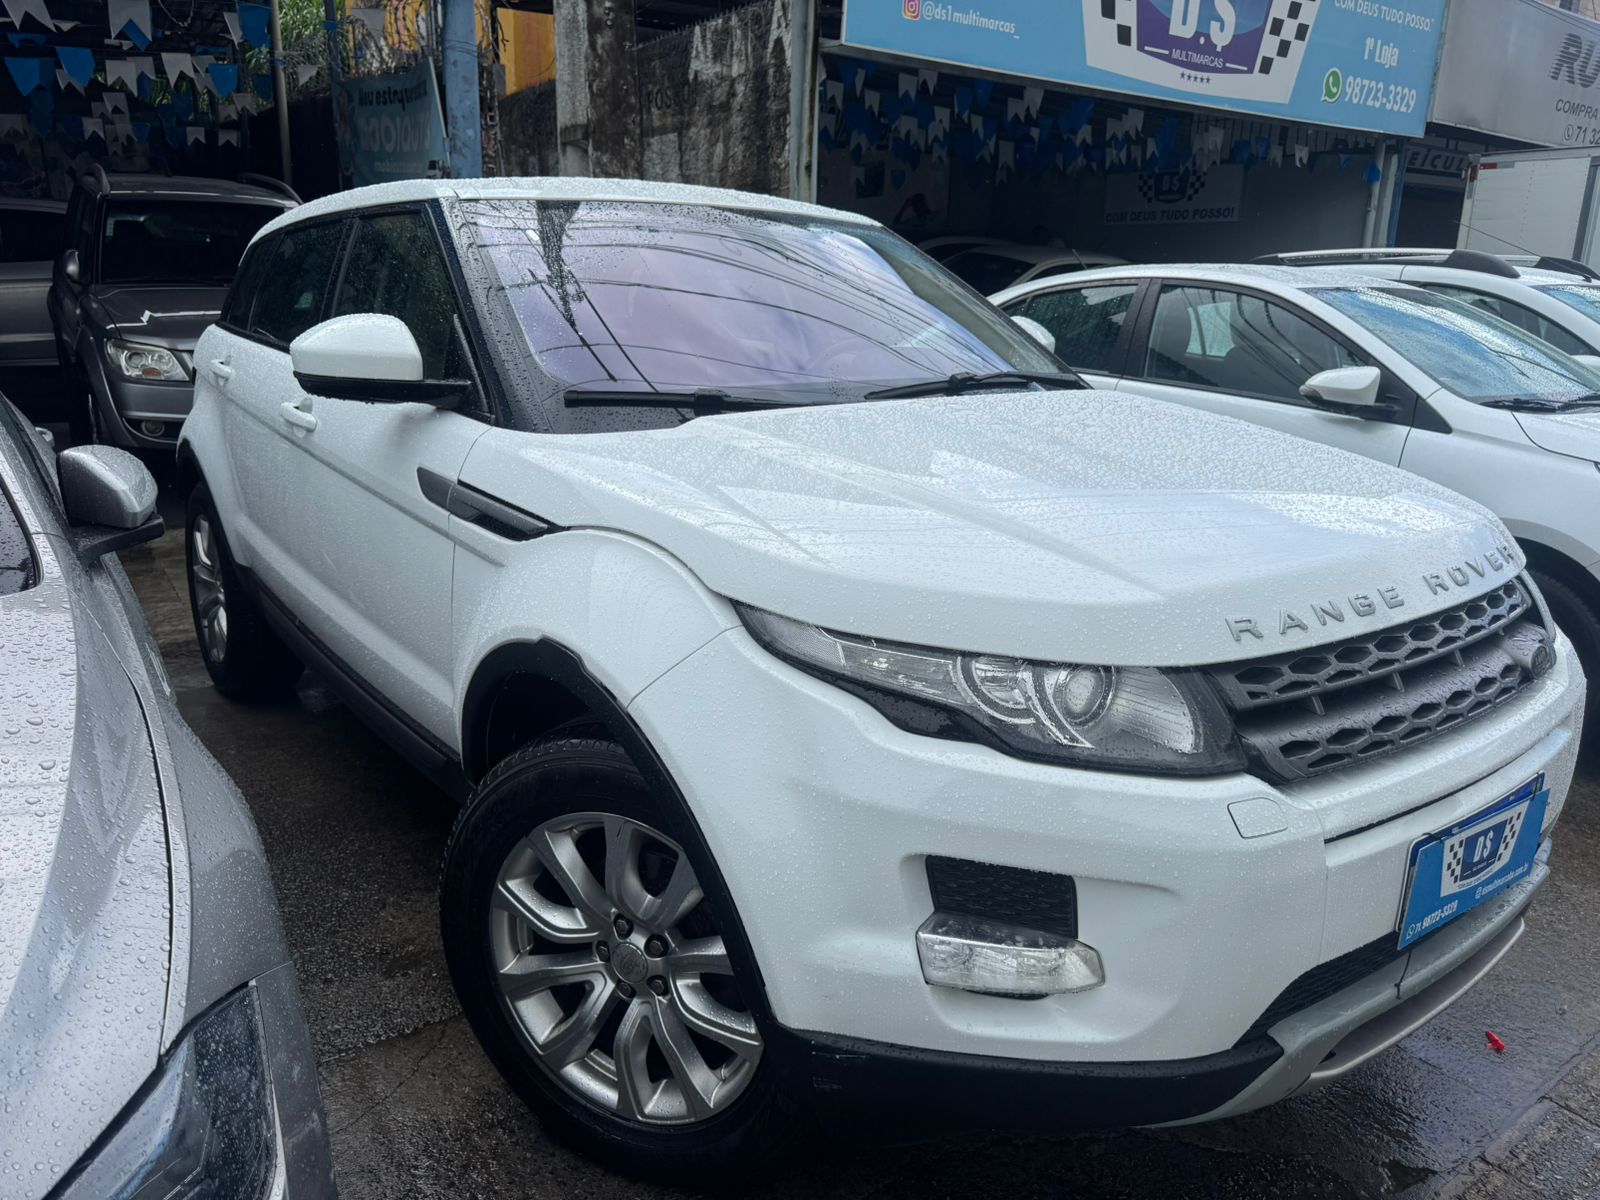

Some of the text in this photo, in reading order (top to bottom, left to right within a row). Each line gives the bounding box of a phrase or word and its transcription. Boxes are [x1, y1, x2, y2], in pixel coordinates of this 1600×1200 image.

[1357, 1, 1379, 17] DEUS
[1380, 6, 1404, 24] TUDO
[1171, 49, 1224, 69] MULTIMARCAS
[1375, 39, 1399, 69] Loja
[1549, 33, 1600, 88] RU
[1344, 75, 1417, 114] 98723-3329
[1555, 98, 1599, 121] COMPRA
[1575, 126, 1588, 143] 71
[1130, 210, 1157, 222] DEUS
[1160, 208, 1189, 221] TUDO
[1192, 206, 1235, 220] POSSO!
[1225, 546, 1515, 642] RANGE ROVER
